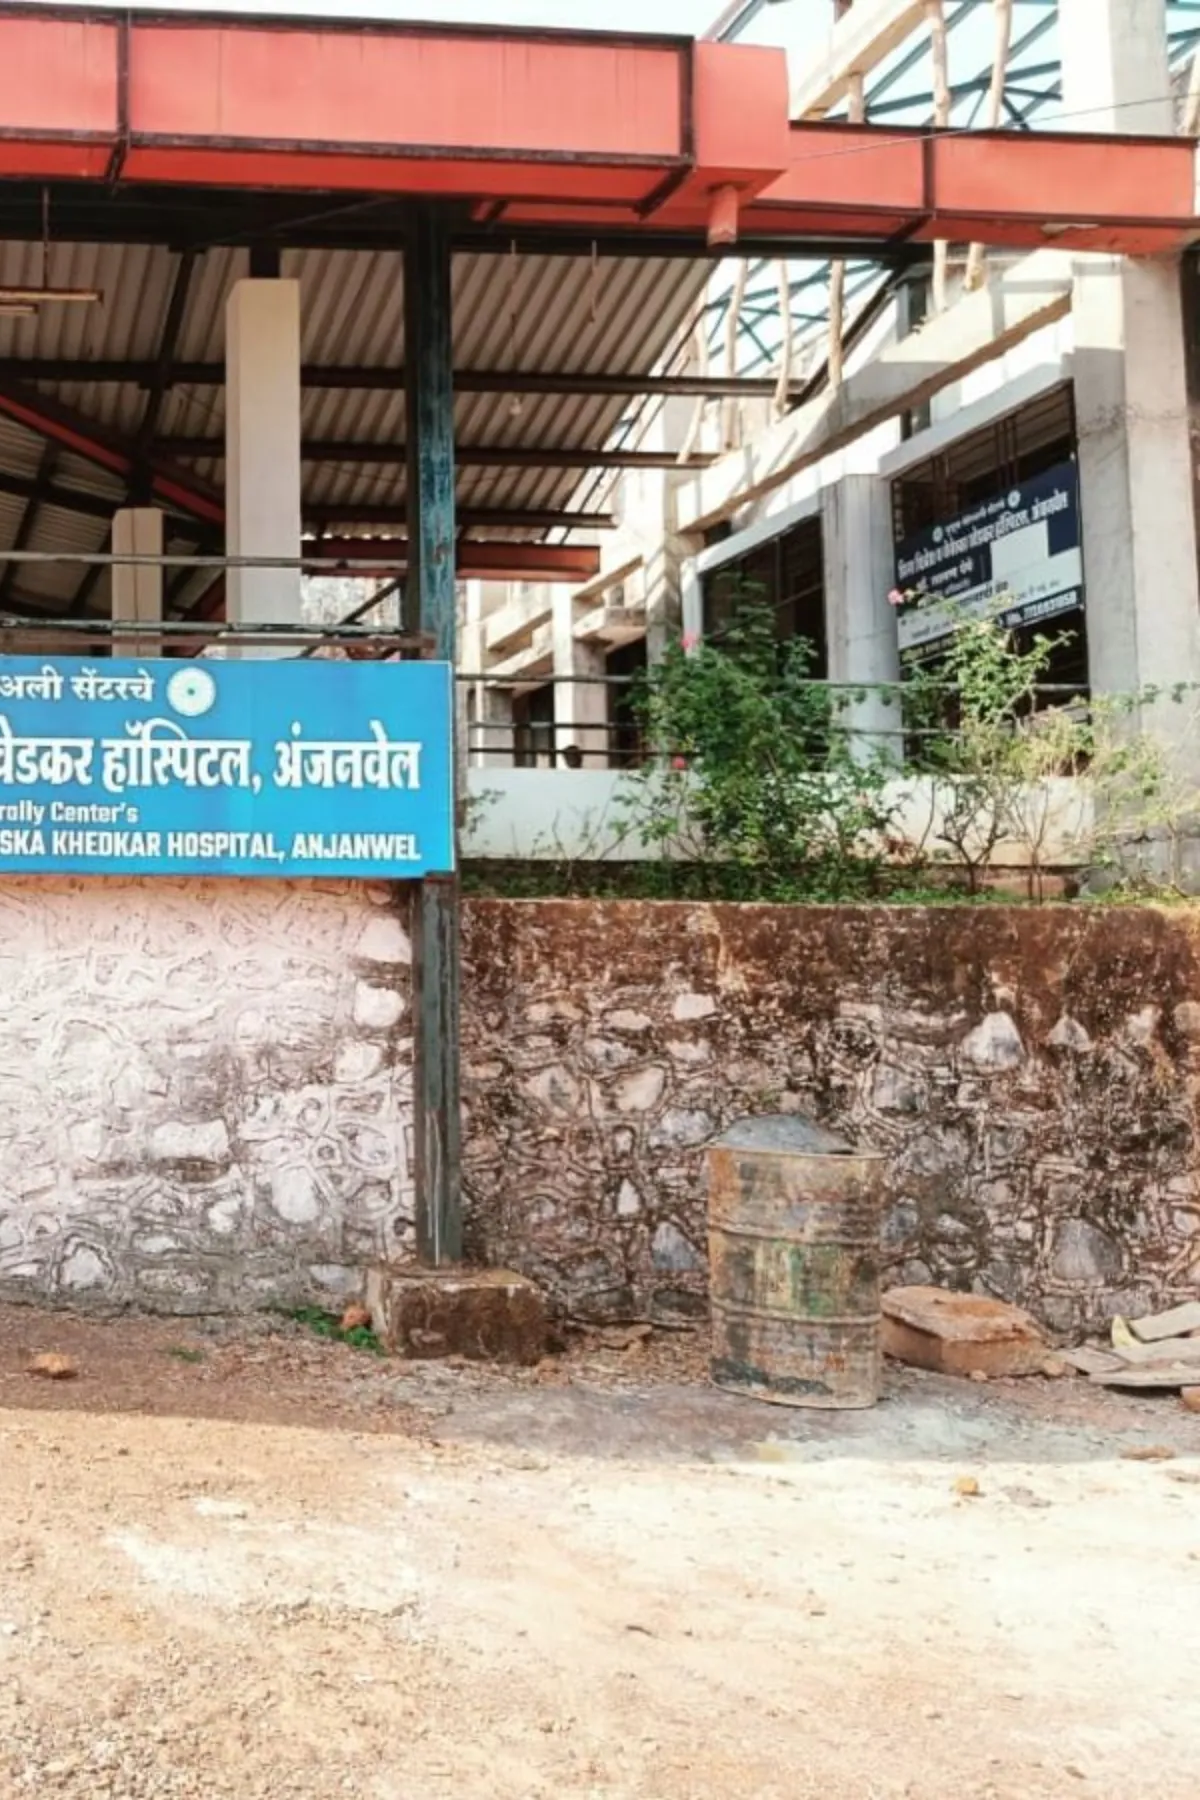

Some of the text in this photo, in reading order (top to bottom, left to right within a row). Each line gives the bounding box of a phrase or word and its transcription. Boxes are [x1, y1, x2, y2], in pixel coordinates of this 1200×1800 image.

[70, 667, 155, 702] सेंटरचे
[101, 717, 262, 794] हॉस्पिटल,
[273, 720, 422, 789] अंजनवेल
[50, 801, 139, 824] Center's
[52, 829, 161, 858] KHEDKAR
[167, 831, 286, 862] HOSPITAL,
[291, 833, 422, 861] ANJANWEL
